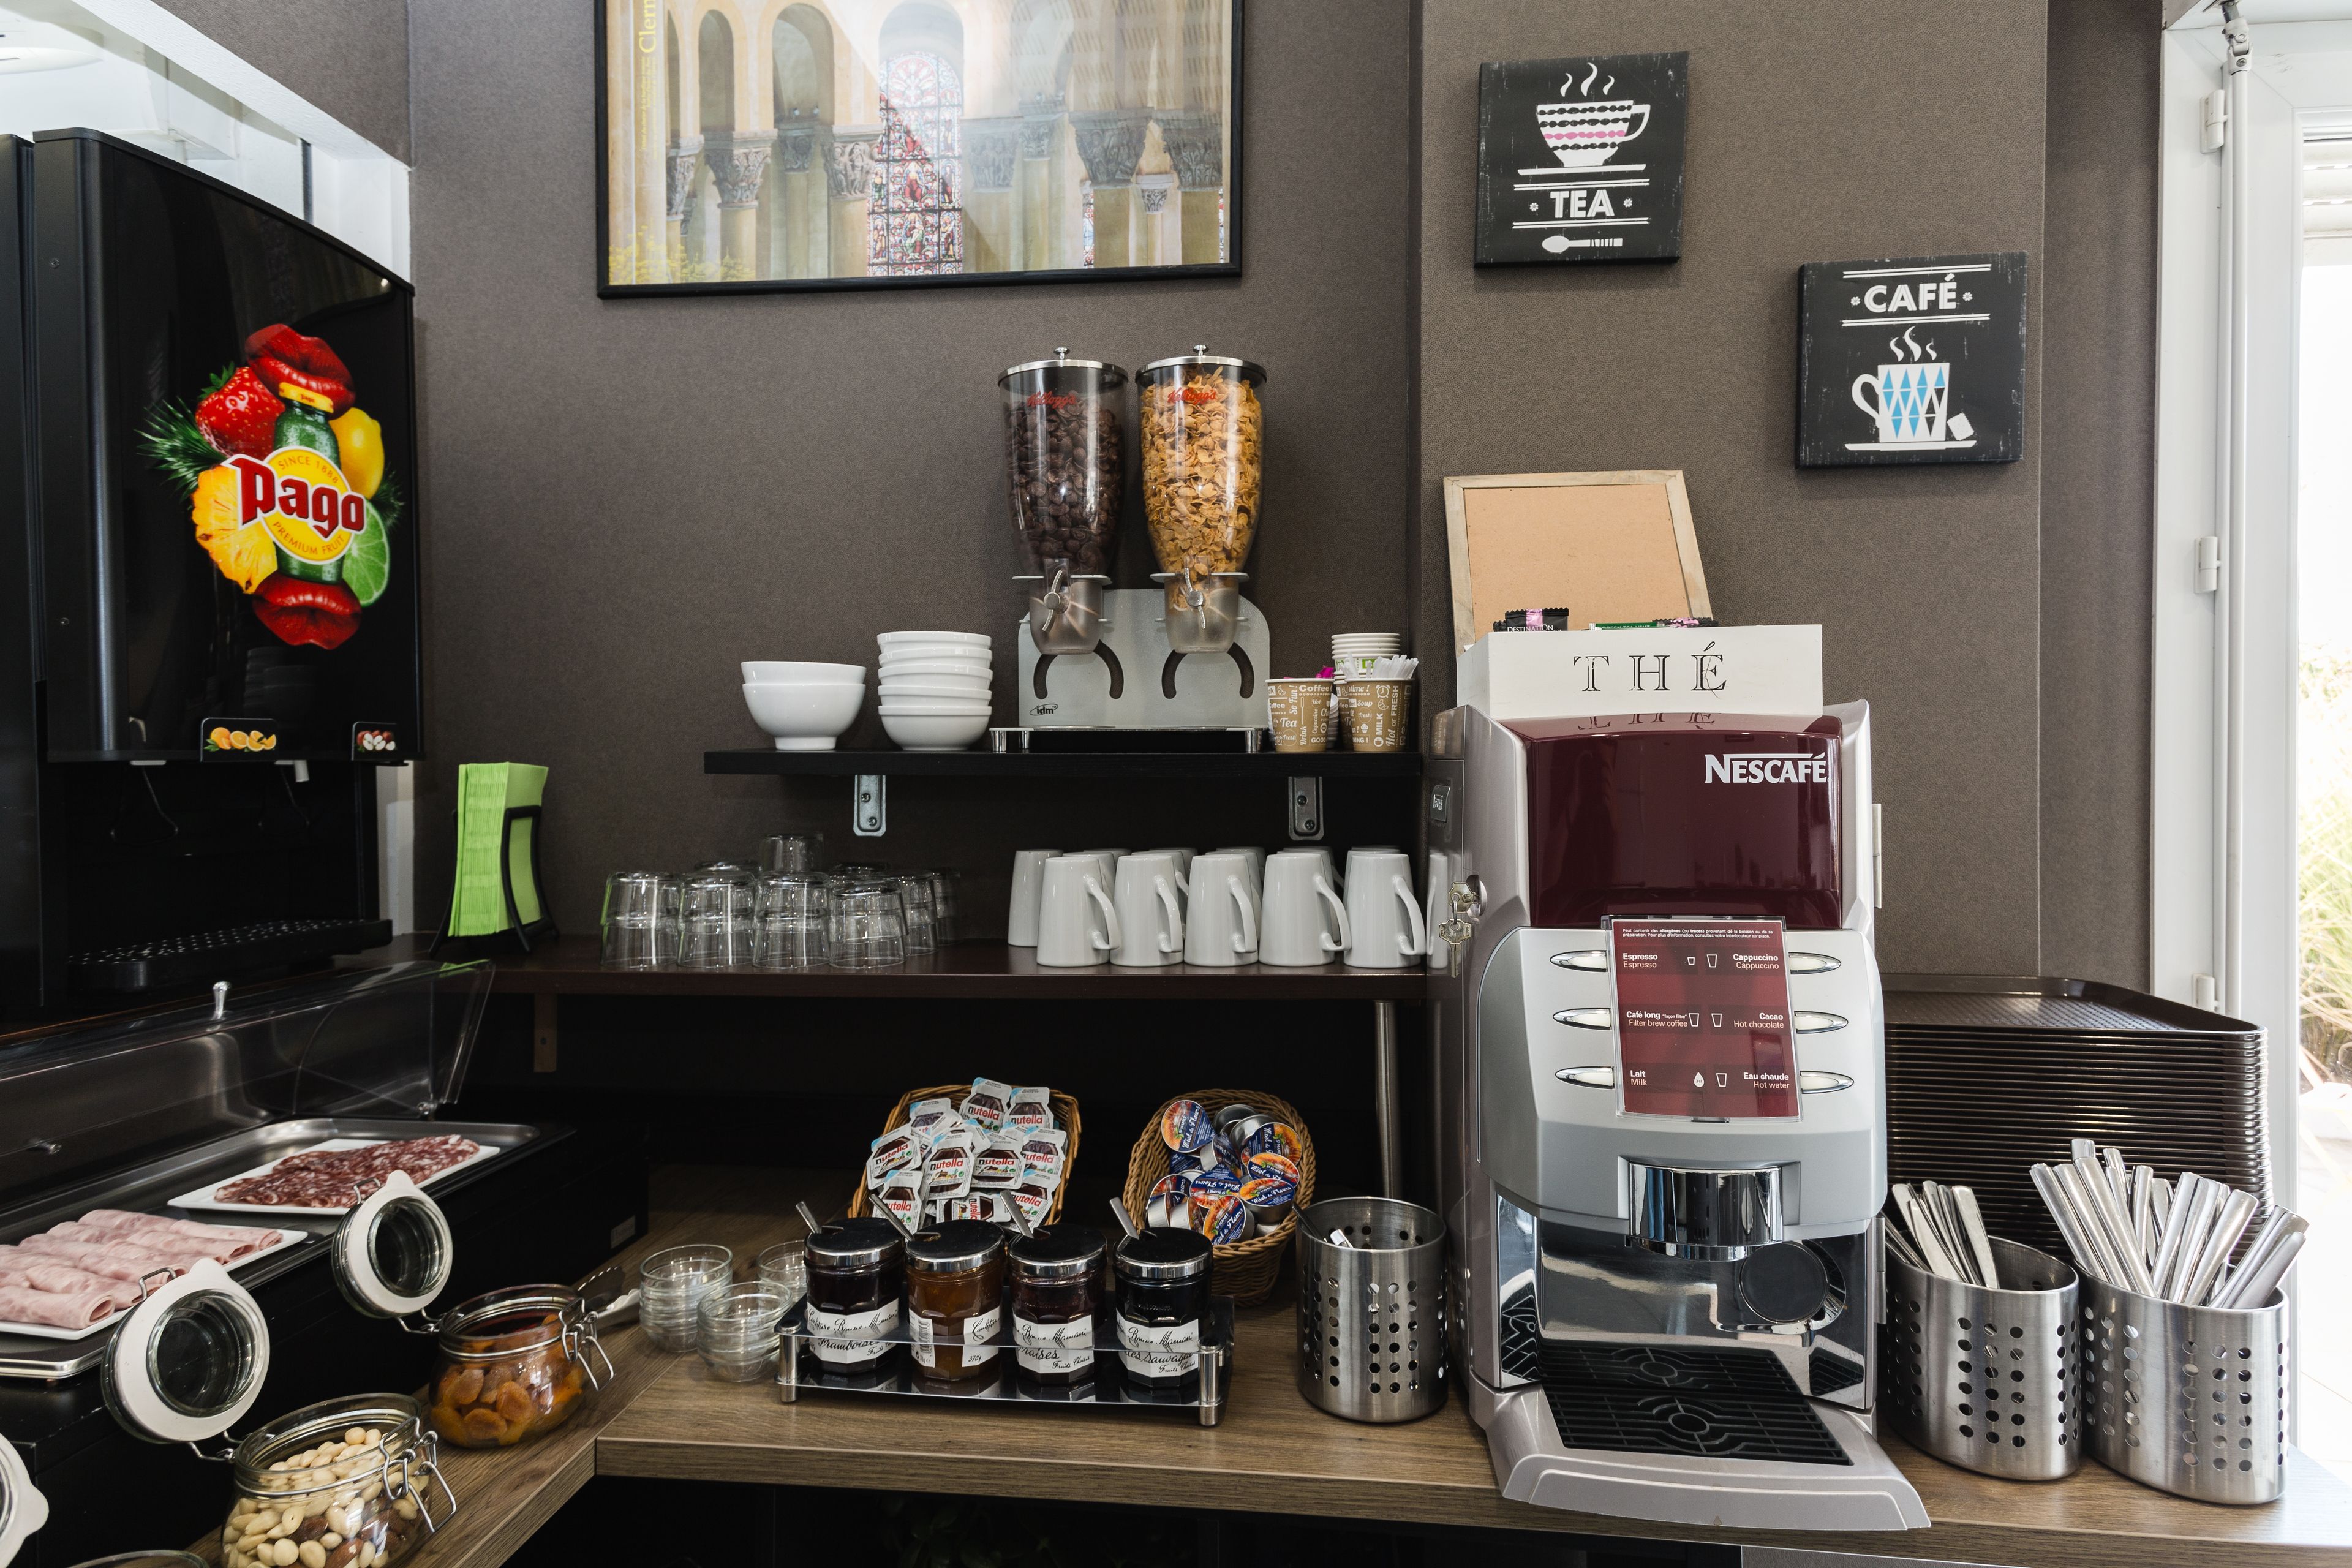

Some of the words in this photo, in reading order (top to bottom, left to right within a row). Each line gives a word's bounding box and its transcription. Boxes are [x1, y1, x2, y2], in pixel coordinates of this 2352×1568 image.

[1550, 190, 1615, 218] TEA
[1864, 273, 1957, 313] CAFÉ
[278, 456, 311, 470] SINCE
[316, 461, 339, 484] 1888
[273, 521, 318, 555] PREMIUM
[322, 535, 345, 553] FRUIT
[1574, 641, 1727, 691] THÉ
[1289, 706, 1298, 715] So
[1280, 717, 1297, 728] Tea
[1386, 729, 1396, 747] Hot
[1705, 752, 1828, 783] NESCAFÉ
[1733, 954, 1779, 962] Cappuccino
[1736, 962, 1779, 970] Cappuccino
[1644, 1011, 1660, 1020] long
[968, 1106, 1000, 1121] nutella
[1011, 1115, 1043, 1125] nutella
[1182, 1133, 1192, 1148] Miel
[1189, 1106, 1200, 1127] Fleurs
[876, 1144, 908, 1164] nutella
[930, 1158, 963, 1170] nutella
[1018, 1348, 1059, 1360] raises
[1052, 1360, 1071, 1369] Fruits
